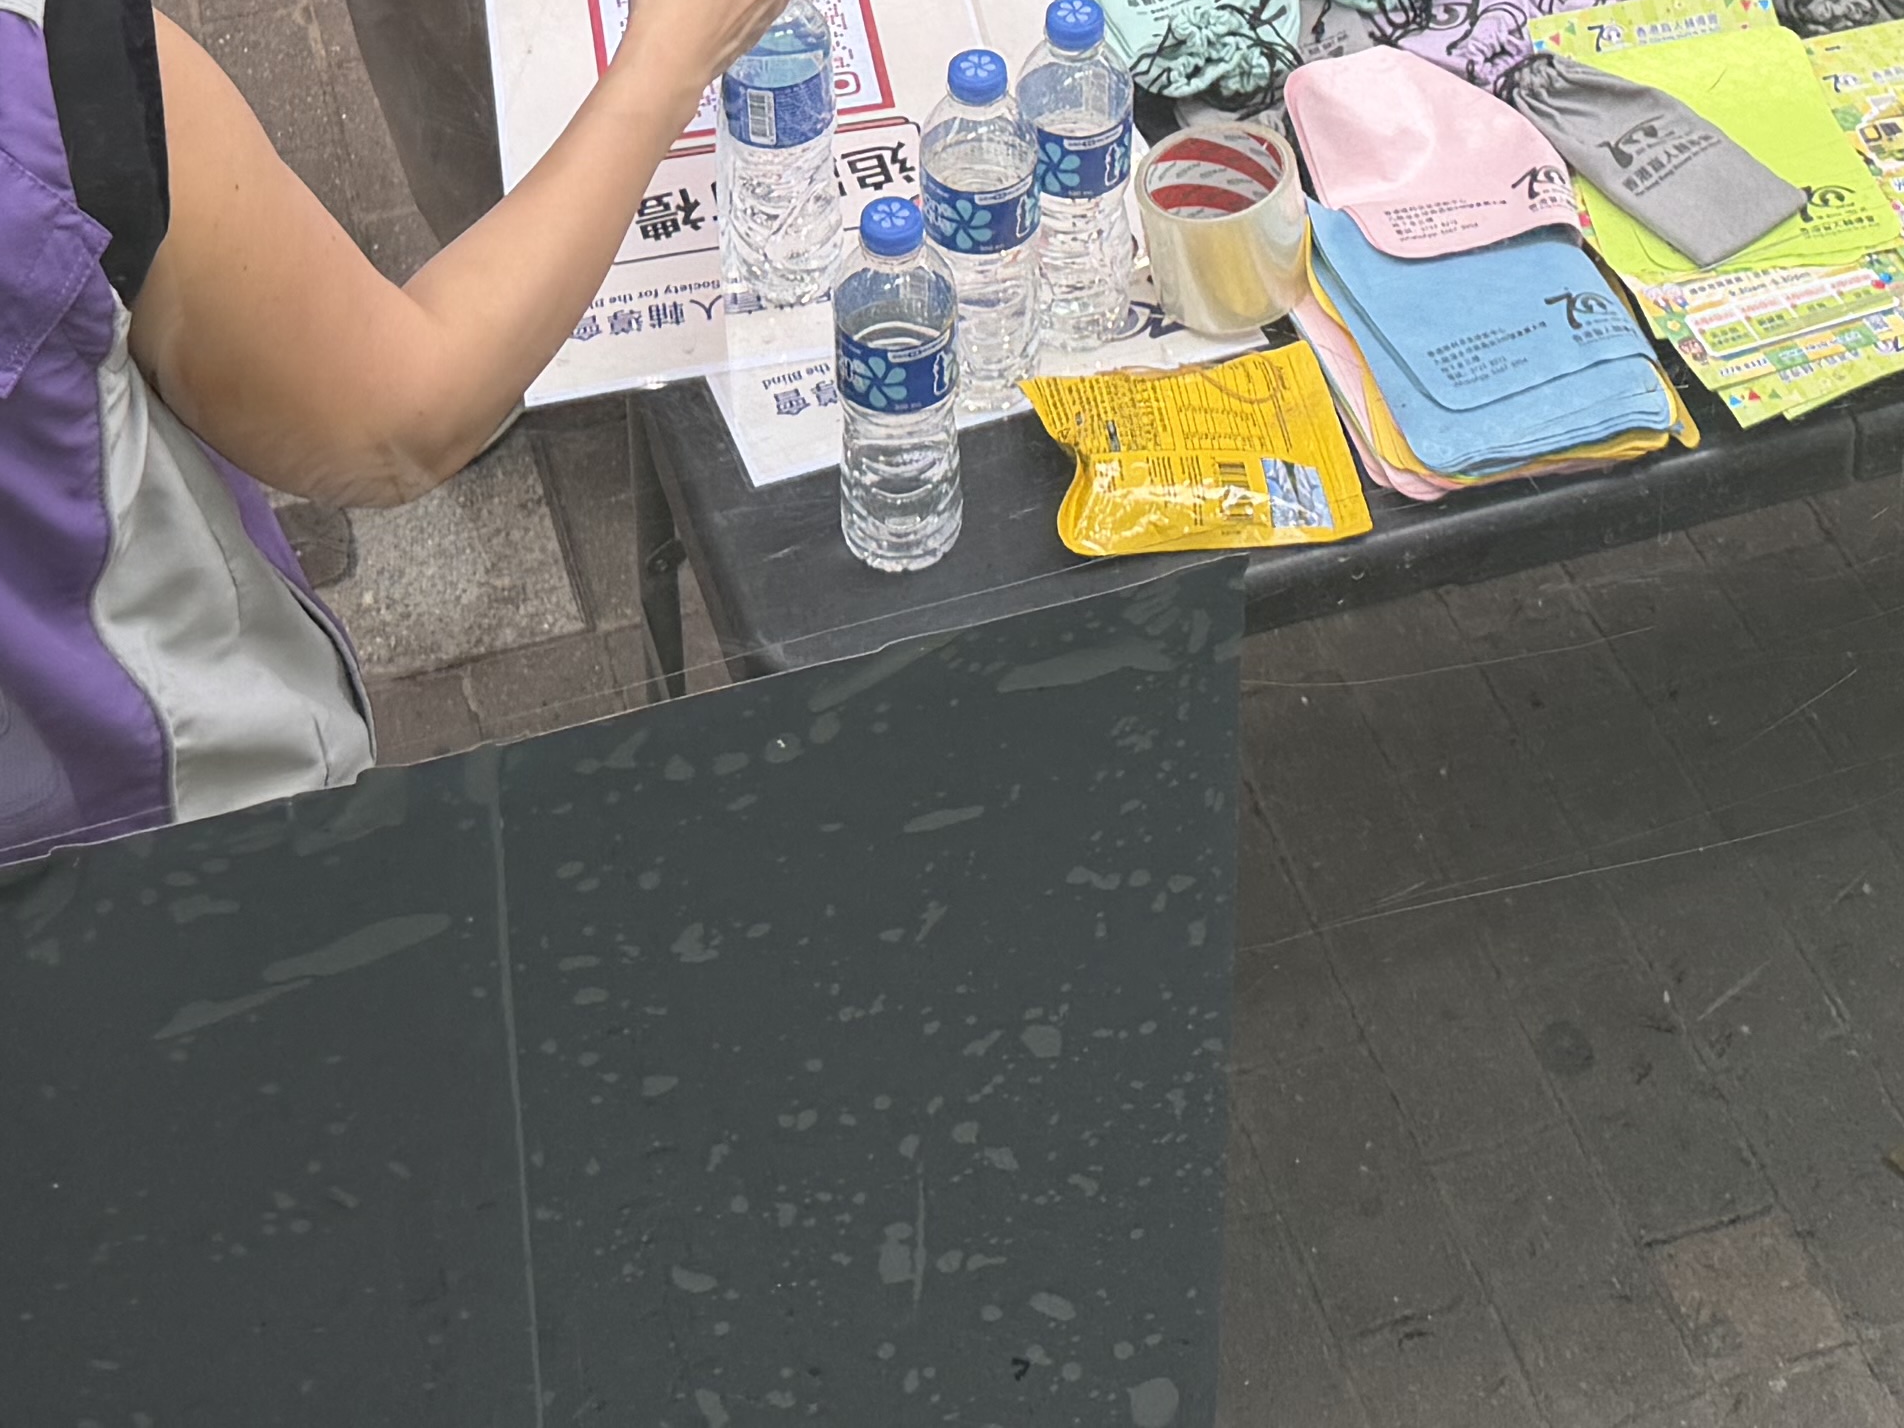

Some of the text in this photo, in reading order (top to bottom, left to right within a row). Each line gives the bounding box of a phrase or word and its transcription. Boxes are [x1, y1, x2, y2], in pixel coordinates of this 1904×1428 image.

[606, 278, 722, 307] Society for the
